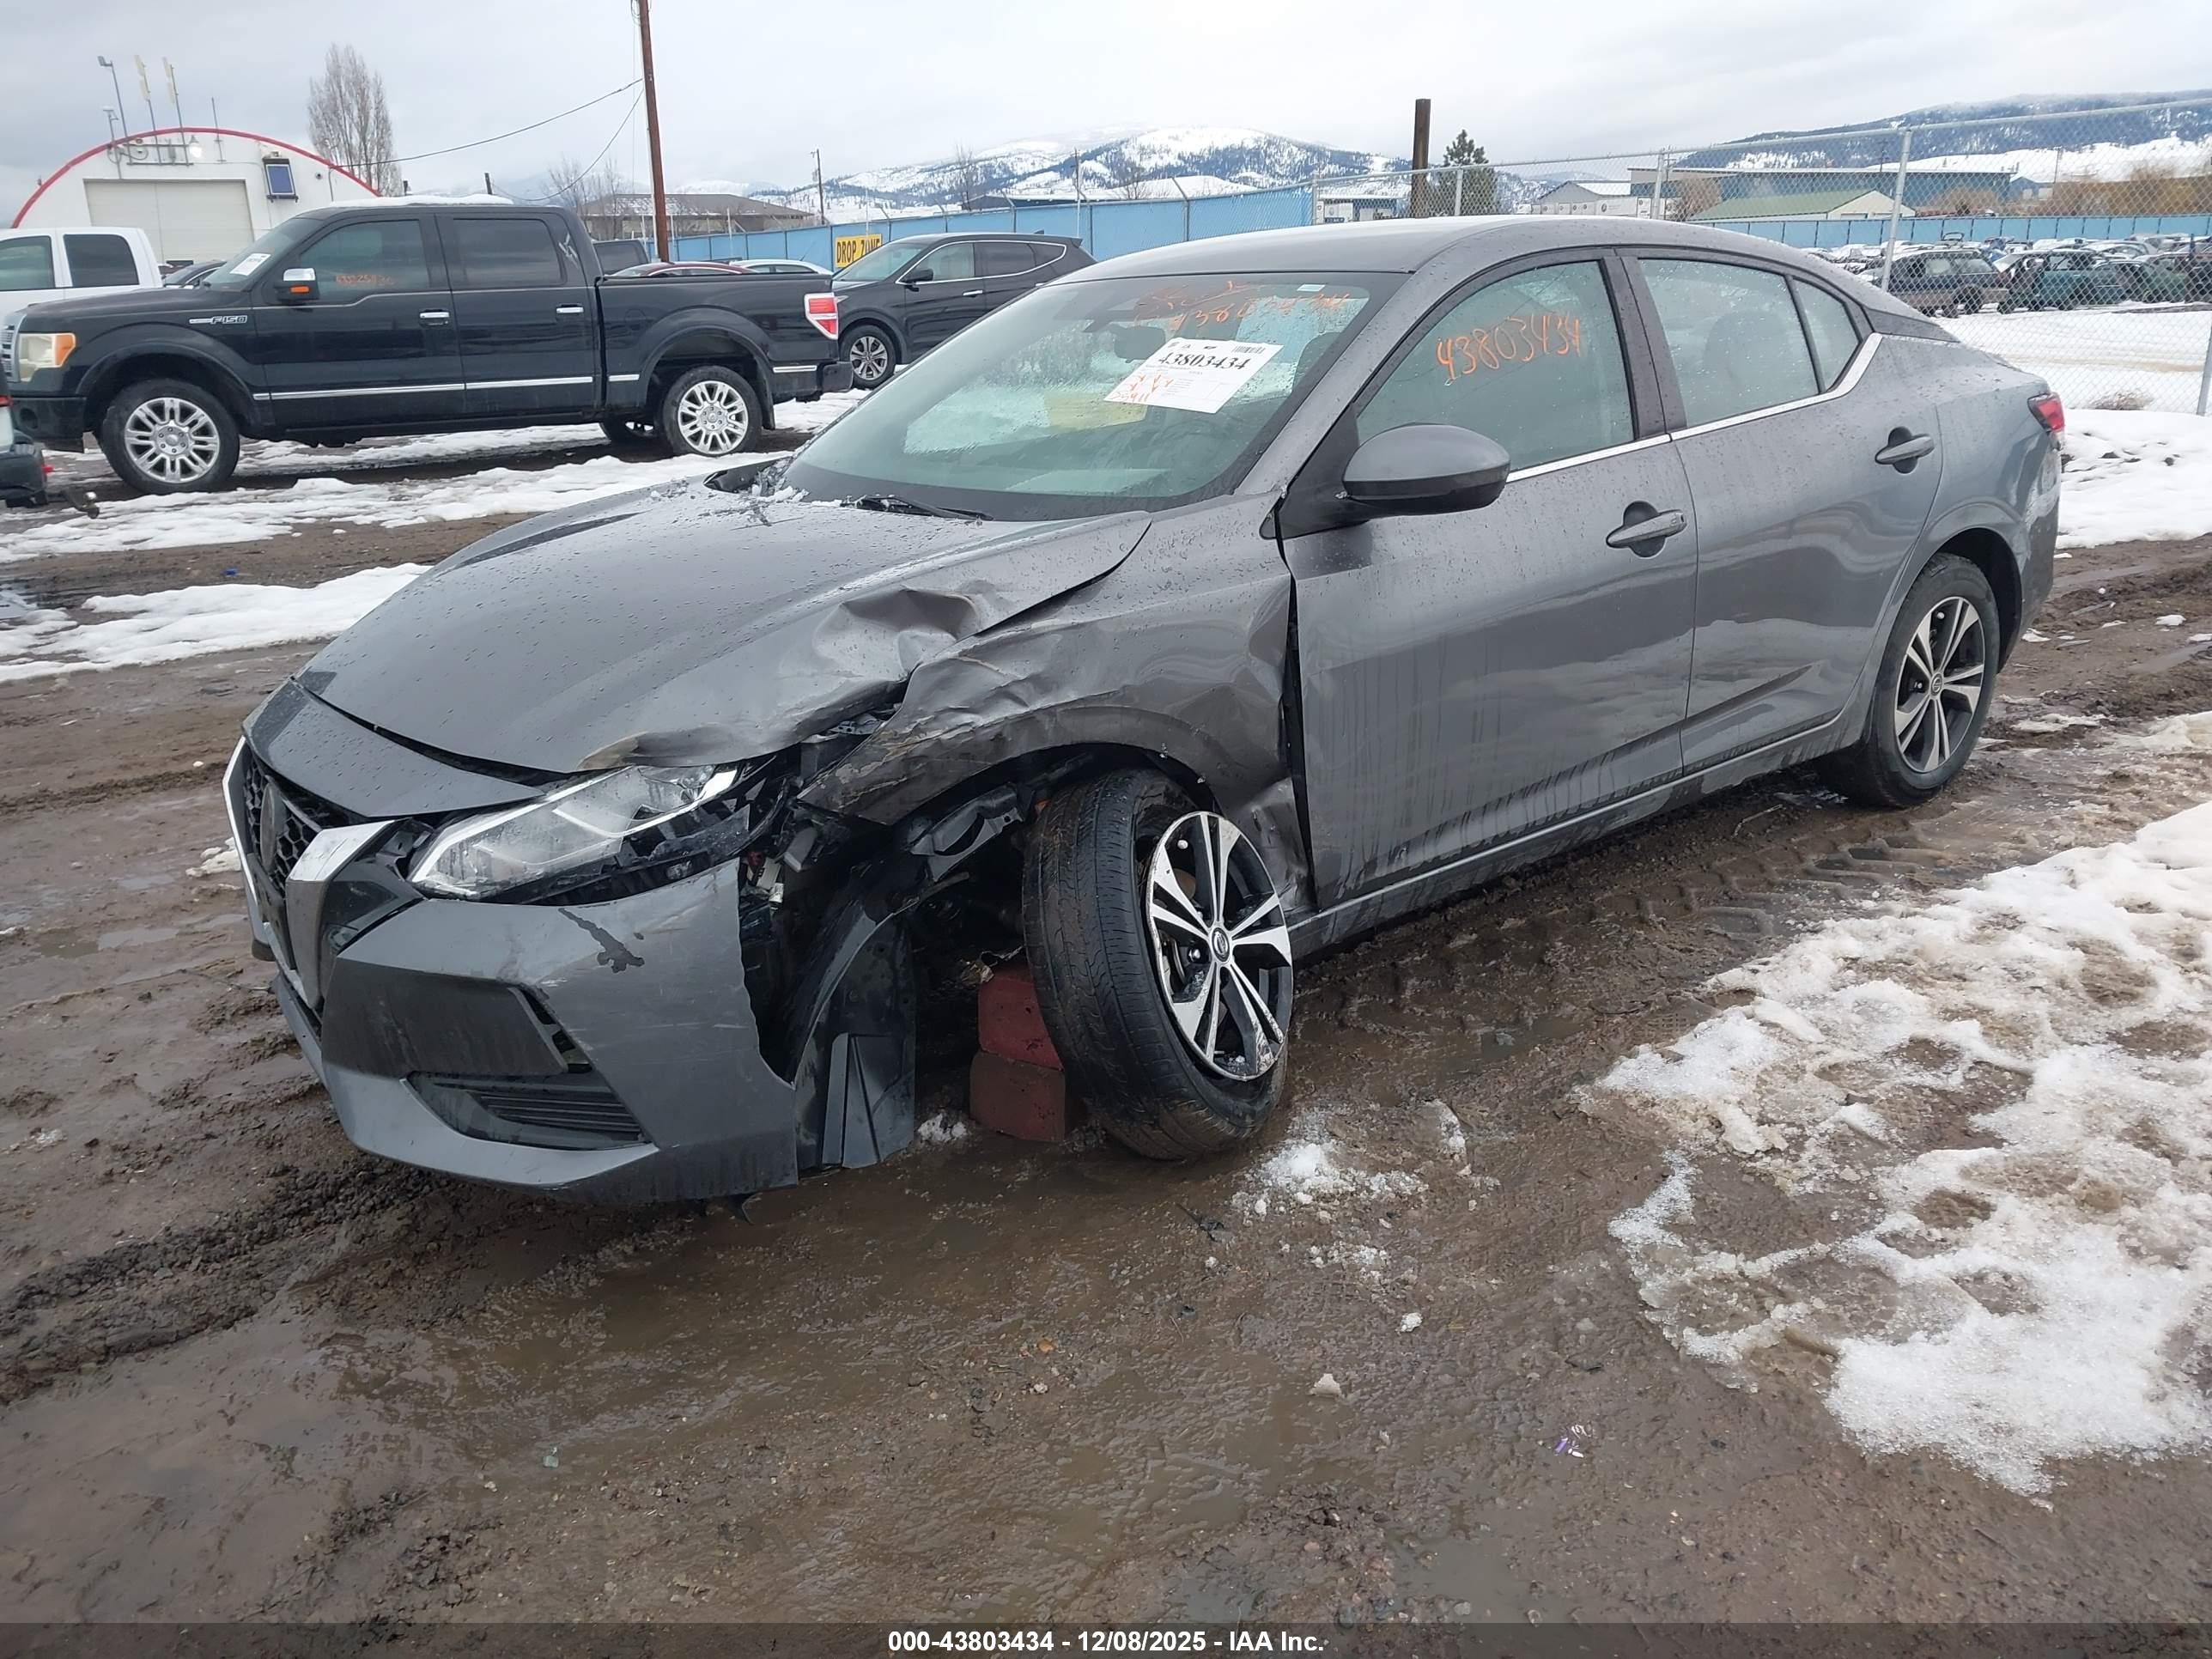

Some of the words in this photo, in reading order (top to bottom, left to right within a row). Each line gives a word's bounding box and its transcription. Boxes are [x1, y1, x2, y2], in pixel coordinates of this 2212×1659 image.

[836, 240, 857, 263] DROP
[1436, 312, 1582, 380] 43803434
[1158, 351, 1251, 370] 43803434
